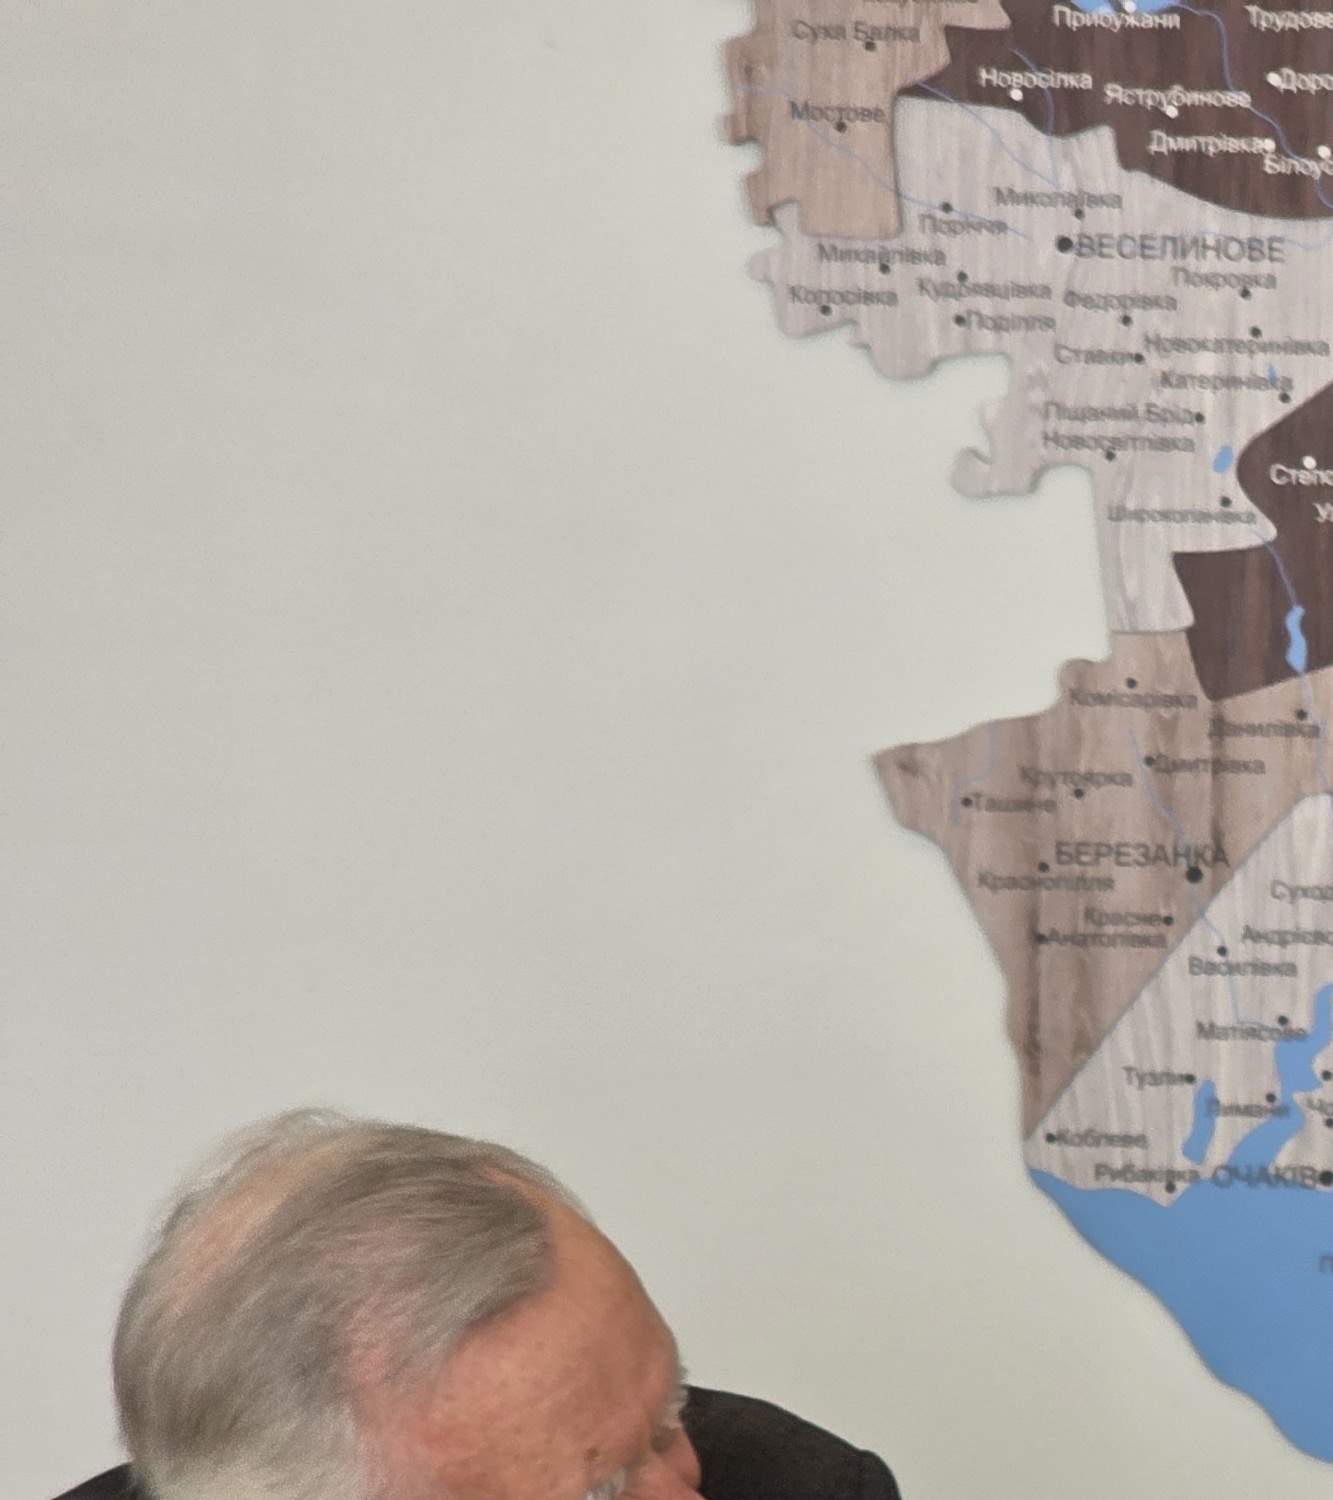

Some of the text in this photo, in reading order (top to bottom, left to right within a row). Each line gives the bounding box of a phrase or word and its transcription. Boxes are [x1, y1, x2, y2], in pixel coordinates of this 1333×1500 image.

[980, 68, 1093, 90] Новосілка
[1104, 87, 1251, 108] Яструбинове
[1149, 132, 1266, 155] Дмитрівка
[1078, 237, 1285, 261] ВЕСЕЛИНОВЕ
[1056, 841, 1229, 867] БЕРЕЗАНКА
[1212, 1165, 1320, 1190] ОЧАКІВ
